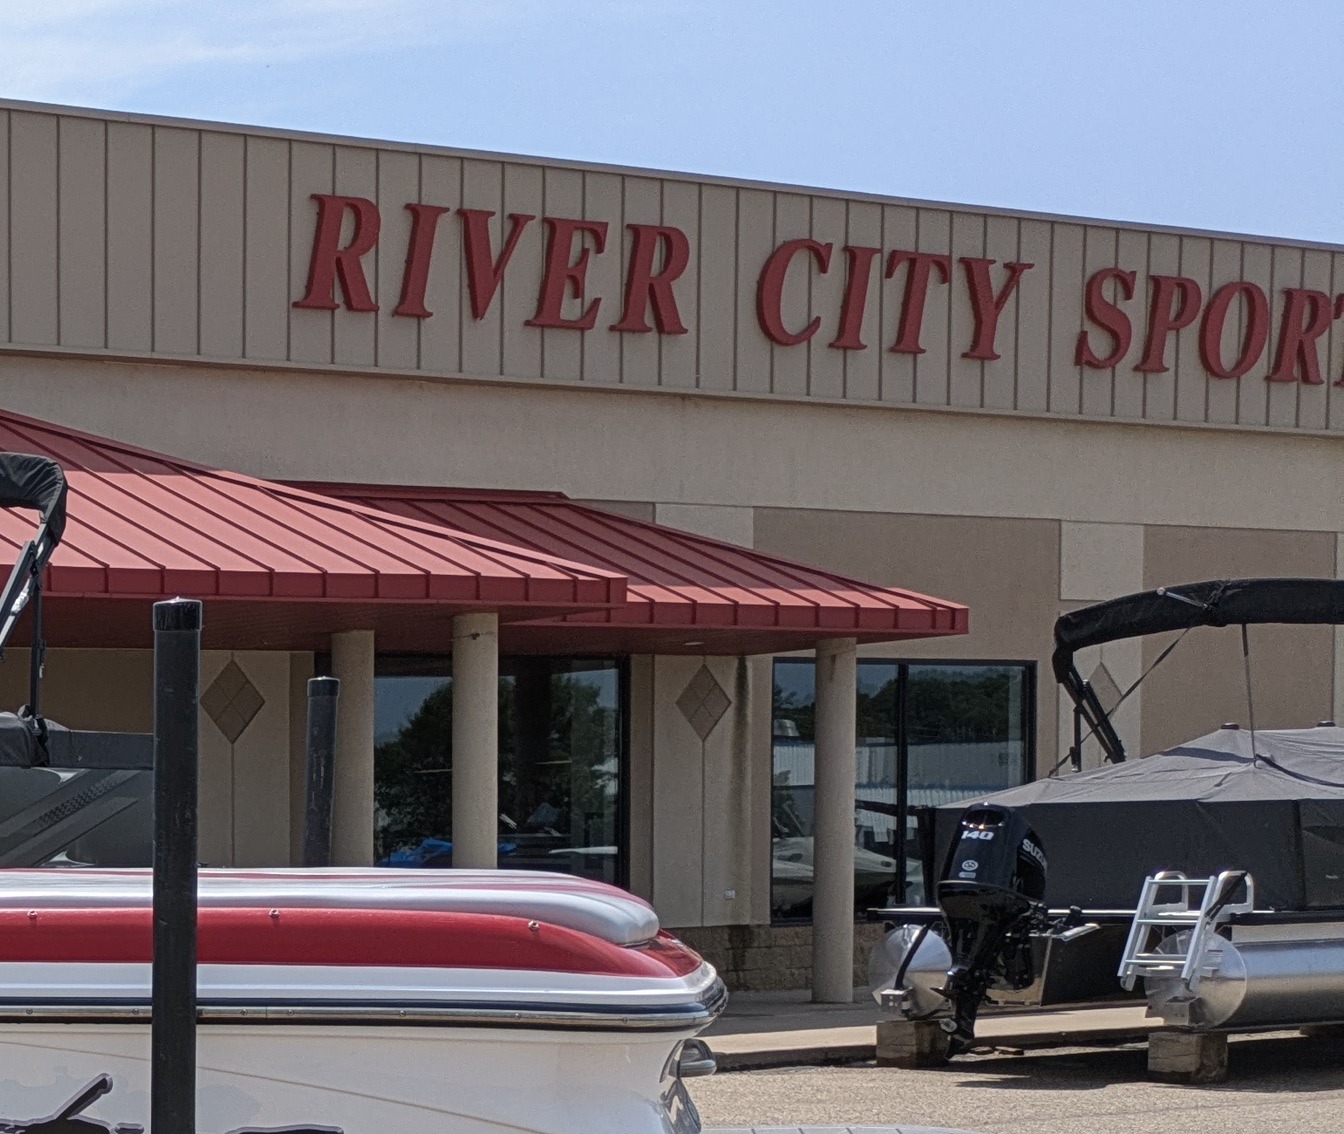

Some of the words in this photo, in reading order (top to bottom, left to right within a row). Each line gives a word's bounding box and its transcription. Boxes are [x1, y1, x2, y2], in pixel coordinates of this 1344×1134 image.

[292, 193, 690, 336] RIVER
[755, 237, 1035, 361] CITY
[1074, 267, 1344, 388] SPOR
[961, 830, 994, 840] 140
